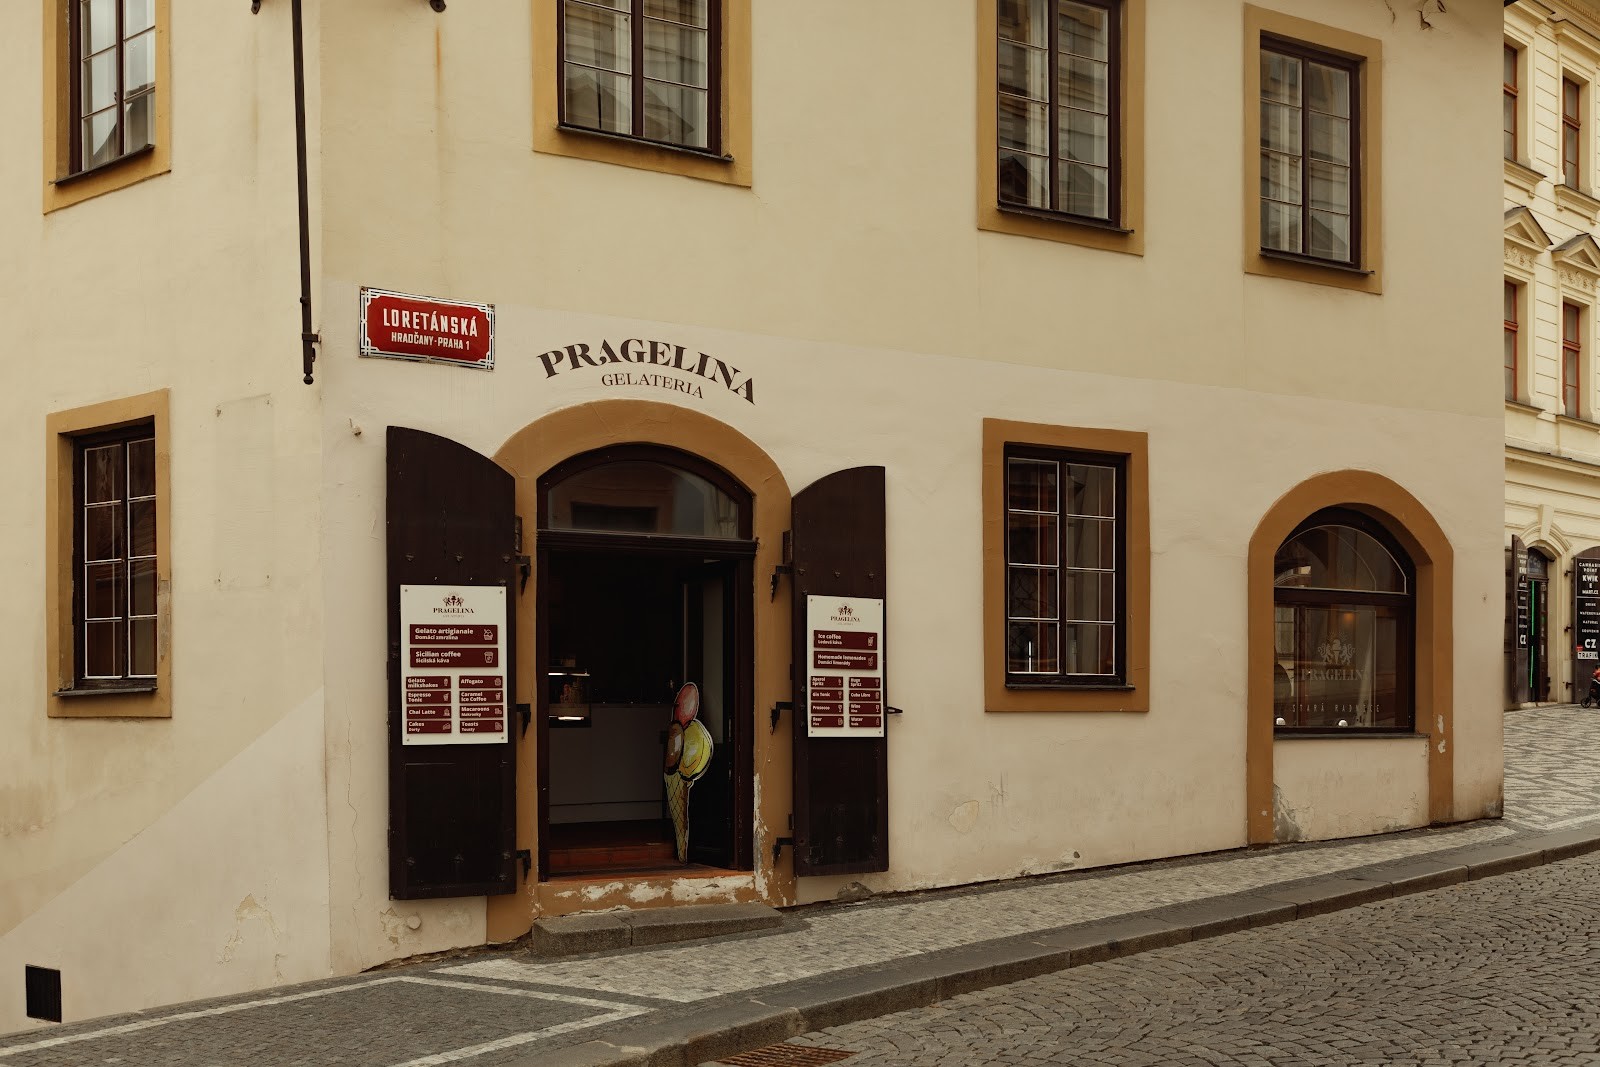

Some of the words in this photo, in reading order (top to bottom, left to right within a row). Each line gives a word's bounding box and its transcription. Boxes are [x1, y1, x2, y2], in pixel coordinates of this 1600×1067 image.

[383, 308, 478, 337] LORETÁNSKÁ
[465, 341, 470, 351] 1
[536, 338, 755, 405] PRAGELINA
[601, 372, 704, 399] GELATERIA
[1582, 574, 1598, 582] KWIK
[438, 628, 473, 636] artigianale
[1584, 638, 1596, 649] CZ
